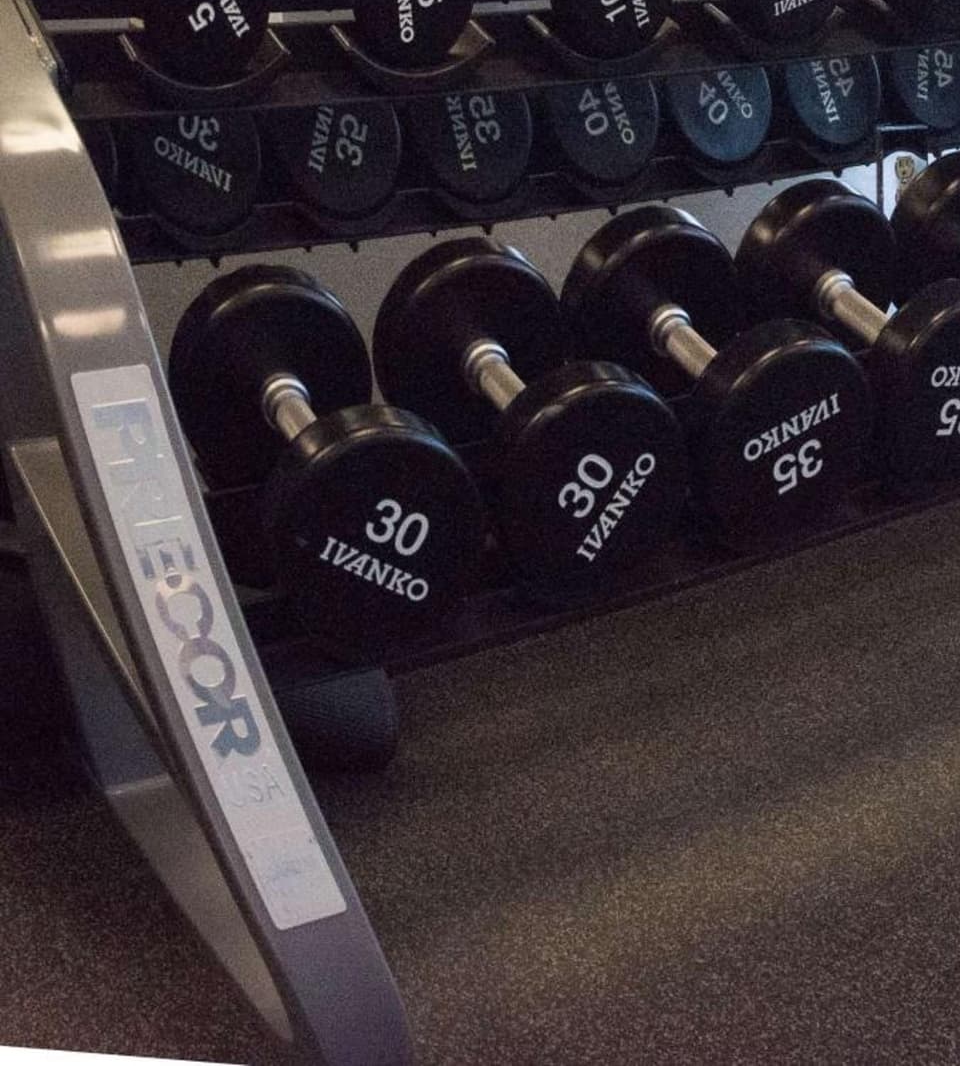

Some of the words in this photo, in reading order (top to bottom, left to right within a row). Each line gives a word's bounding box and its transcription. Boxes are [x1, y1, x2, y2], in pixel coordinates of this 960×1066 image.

[188, 1, 216, 33] 5
[743, 393, 841, 462] IVANKO
[558, 453, 614, 520] 30
[771, 439, 824, 494] 35
[365, 498, 430, 557] 30
[577, 452, 656, 562] IVANKO
[318, 536, 430, 603] IVANKO
